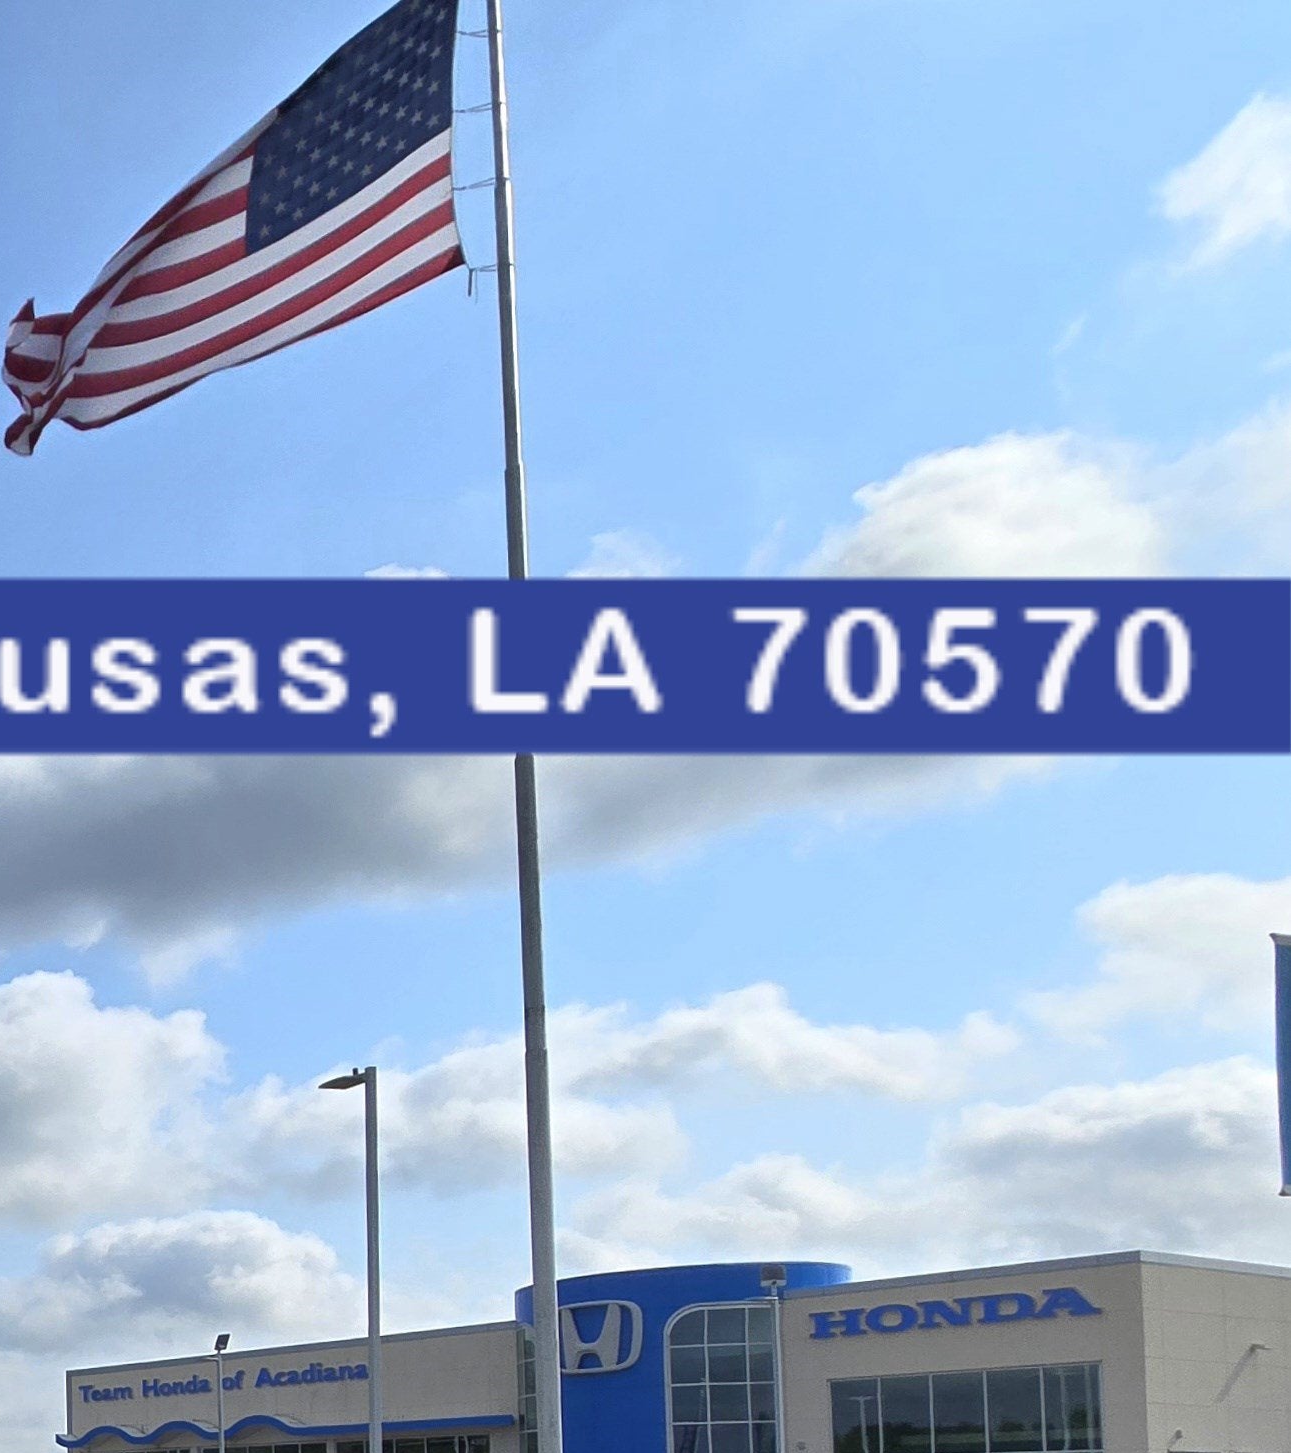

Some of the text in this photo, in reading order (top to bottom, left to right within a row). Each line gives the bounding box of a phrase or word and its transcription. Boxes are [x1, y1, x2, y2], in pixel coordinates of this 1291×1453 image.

[808, 1287, 1104, 1340] HONDA
[78, 1362, 370, 1403] Team Honda of Acadiana
